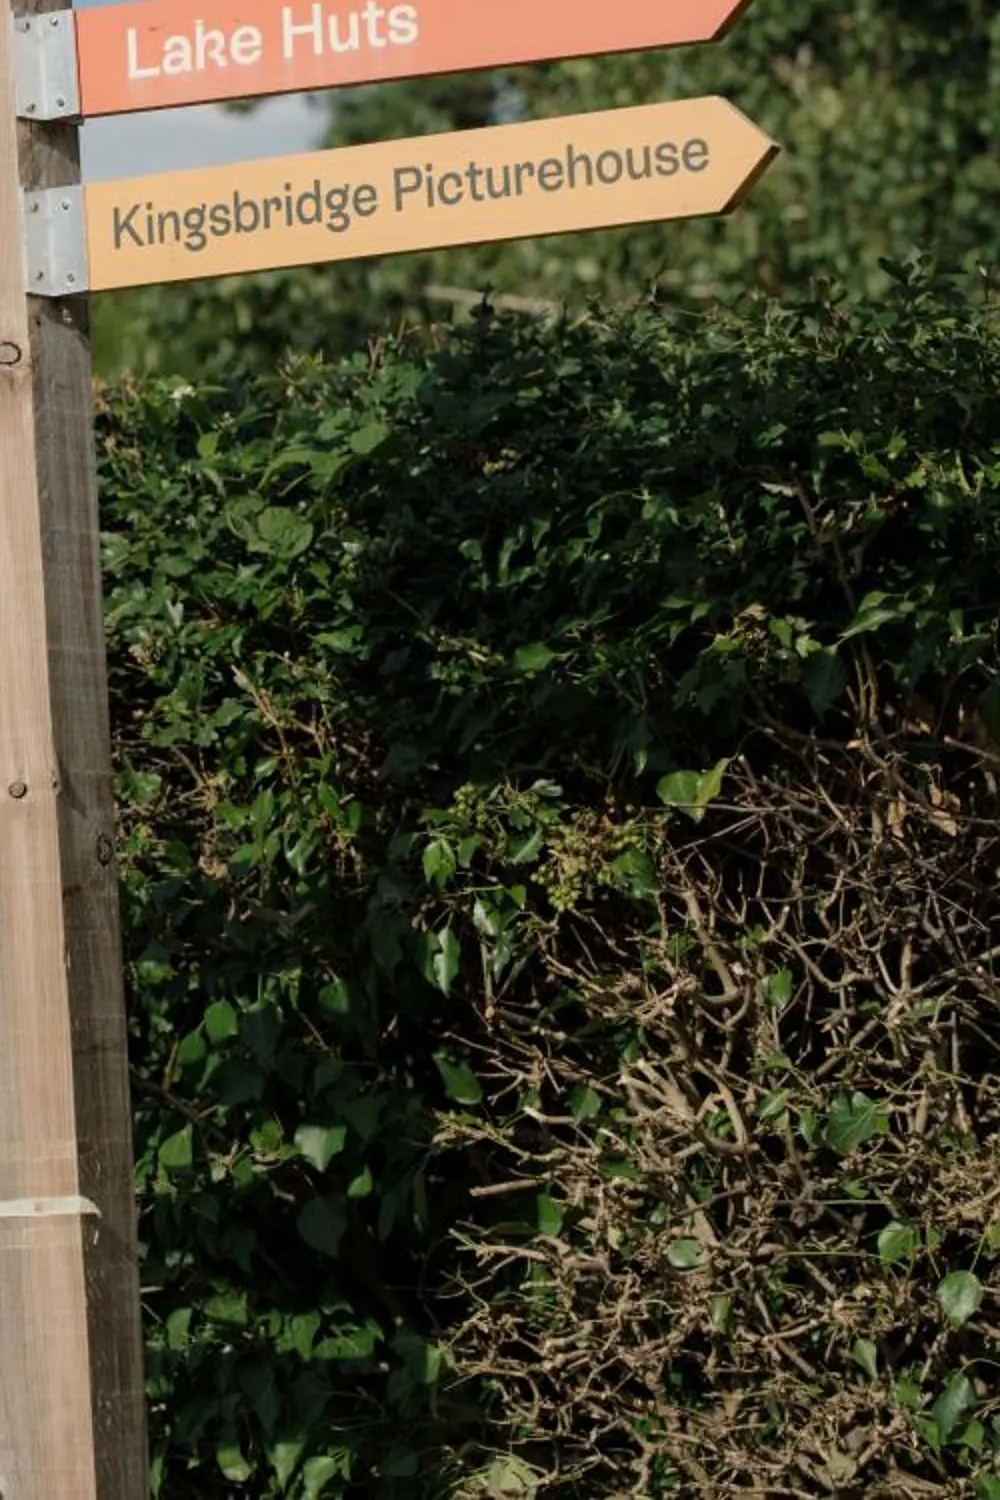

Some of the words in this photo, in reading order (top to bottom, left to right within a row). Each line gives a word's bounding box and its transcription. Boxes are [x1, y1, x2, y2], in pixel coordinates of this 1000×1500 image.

[126, 20, 263, 81] Lake
[282, 0, 419, 59] Huts
[112, 180, 378, 251] Kingsbridge
[394, 137, 710, 211] Picturehouse
